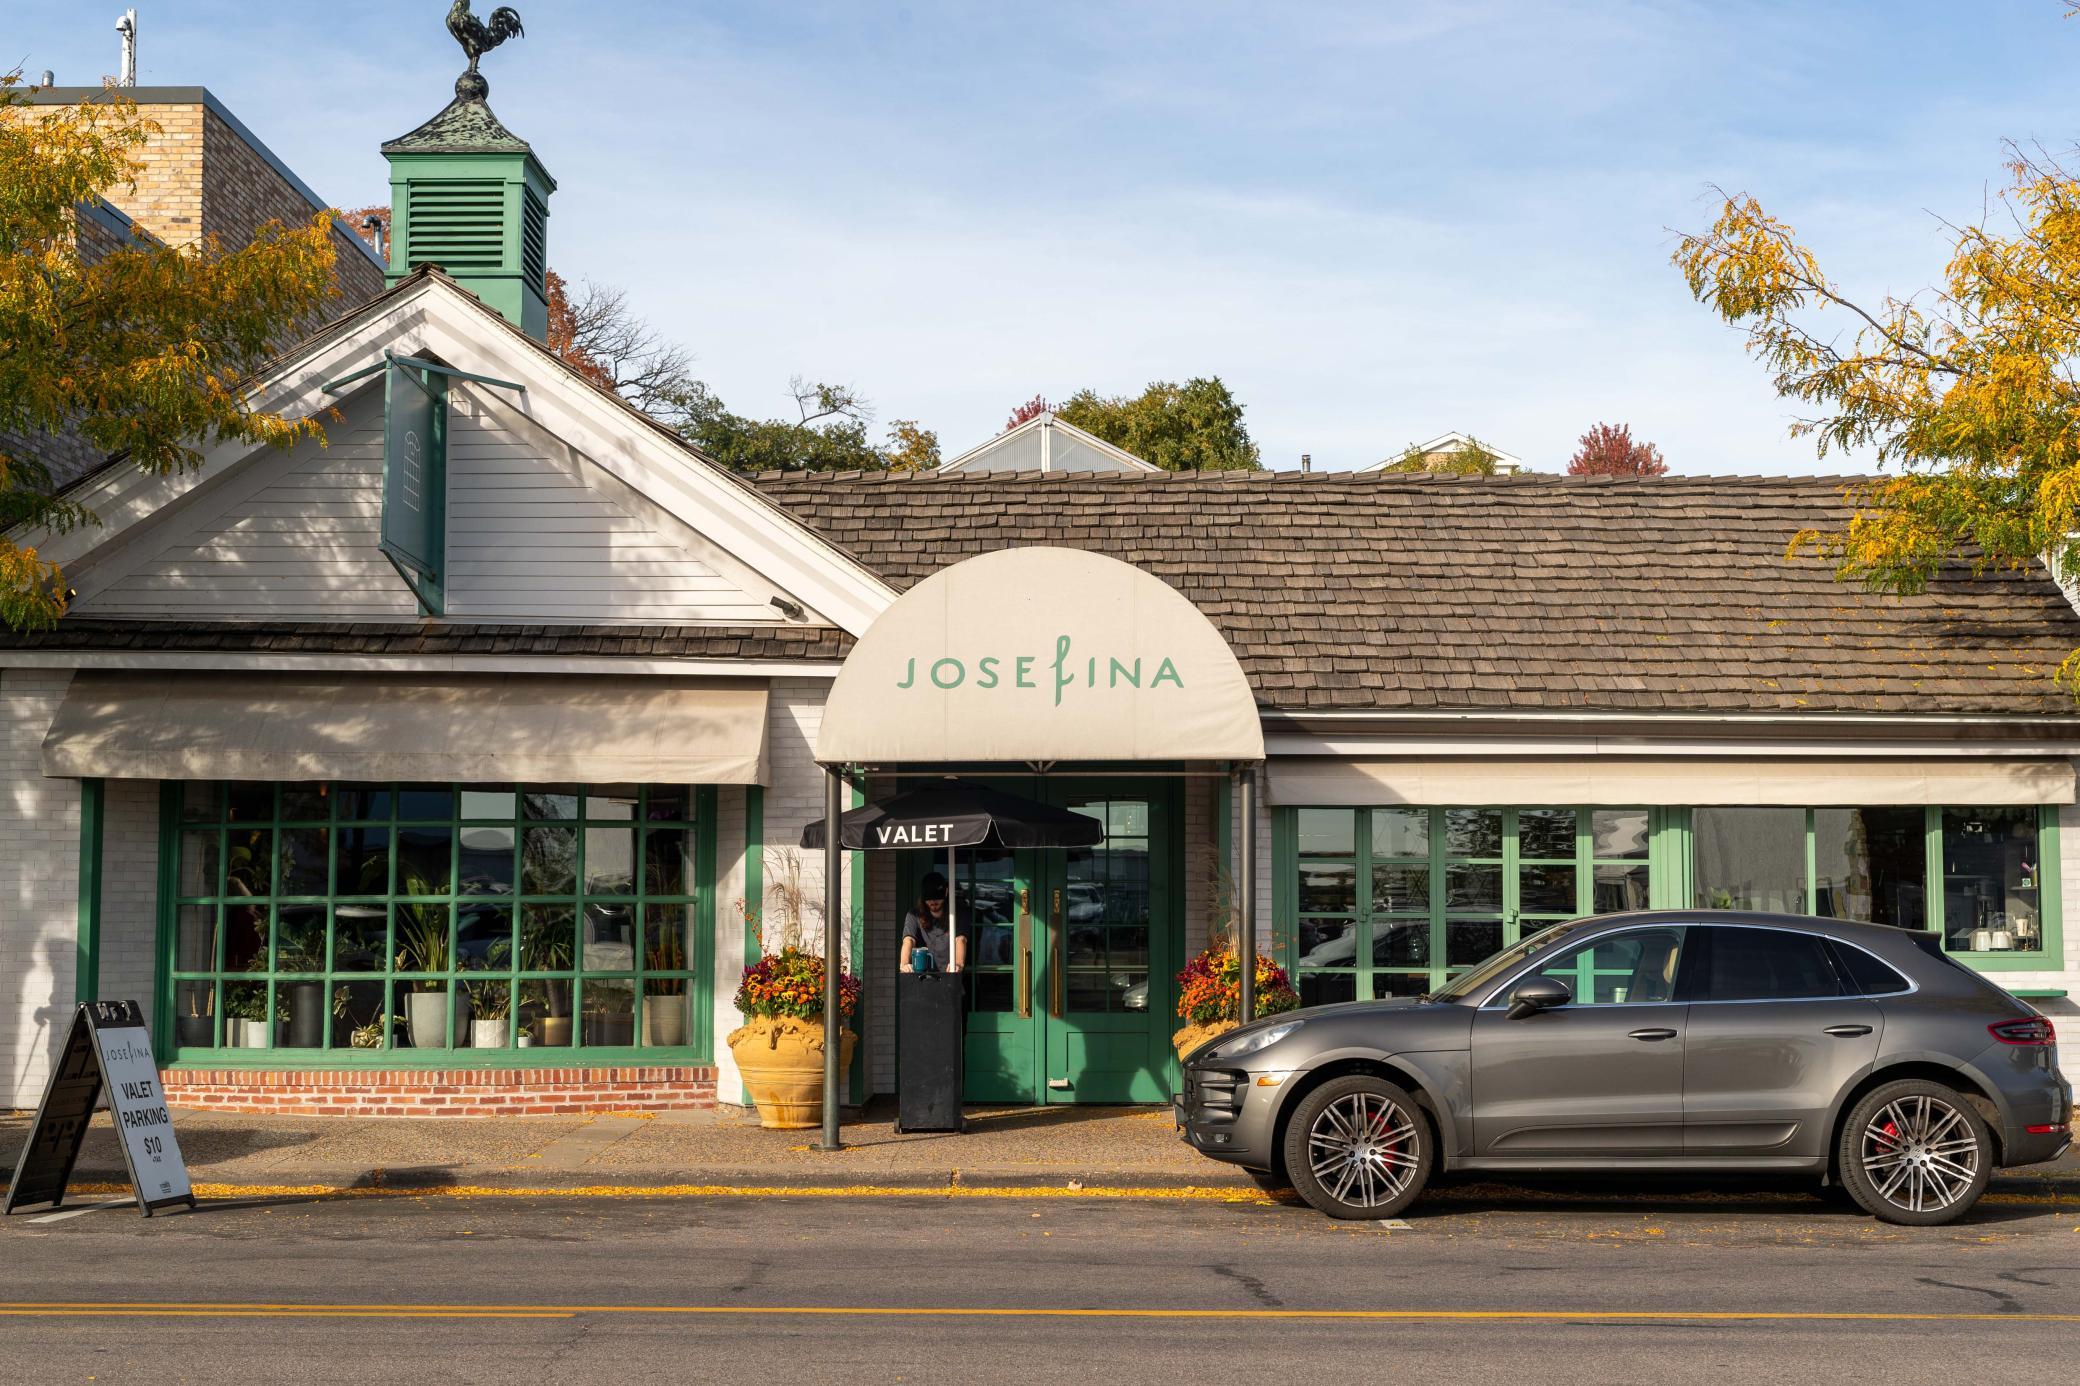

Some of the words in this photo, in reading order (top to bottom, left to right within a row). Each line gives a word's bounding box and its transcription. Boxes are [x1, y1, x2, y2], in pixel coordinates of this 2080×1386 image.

[876, 823, 955, 845] VALET
[121, 1081, 154, 1100] VALET
[122, 1107, 168, 1129] PARKING
[143, 1135, 162, 1155] $10
